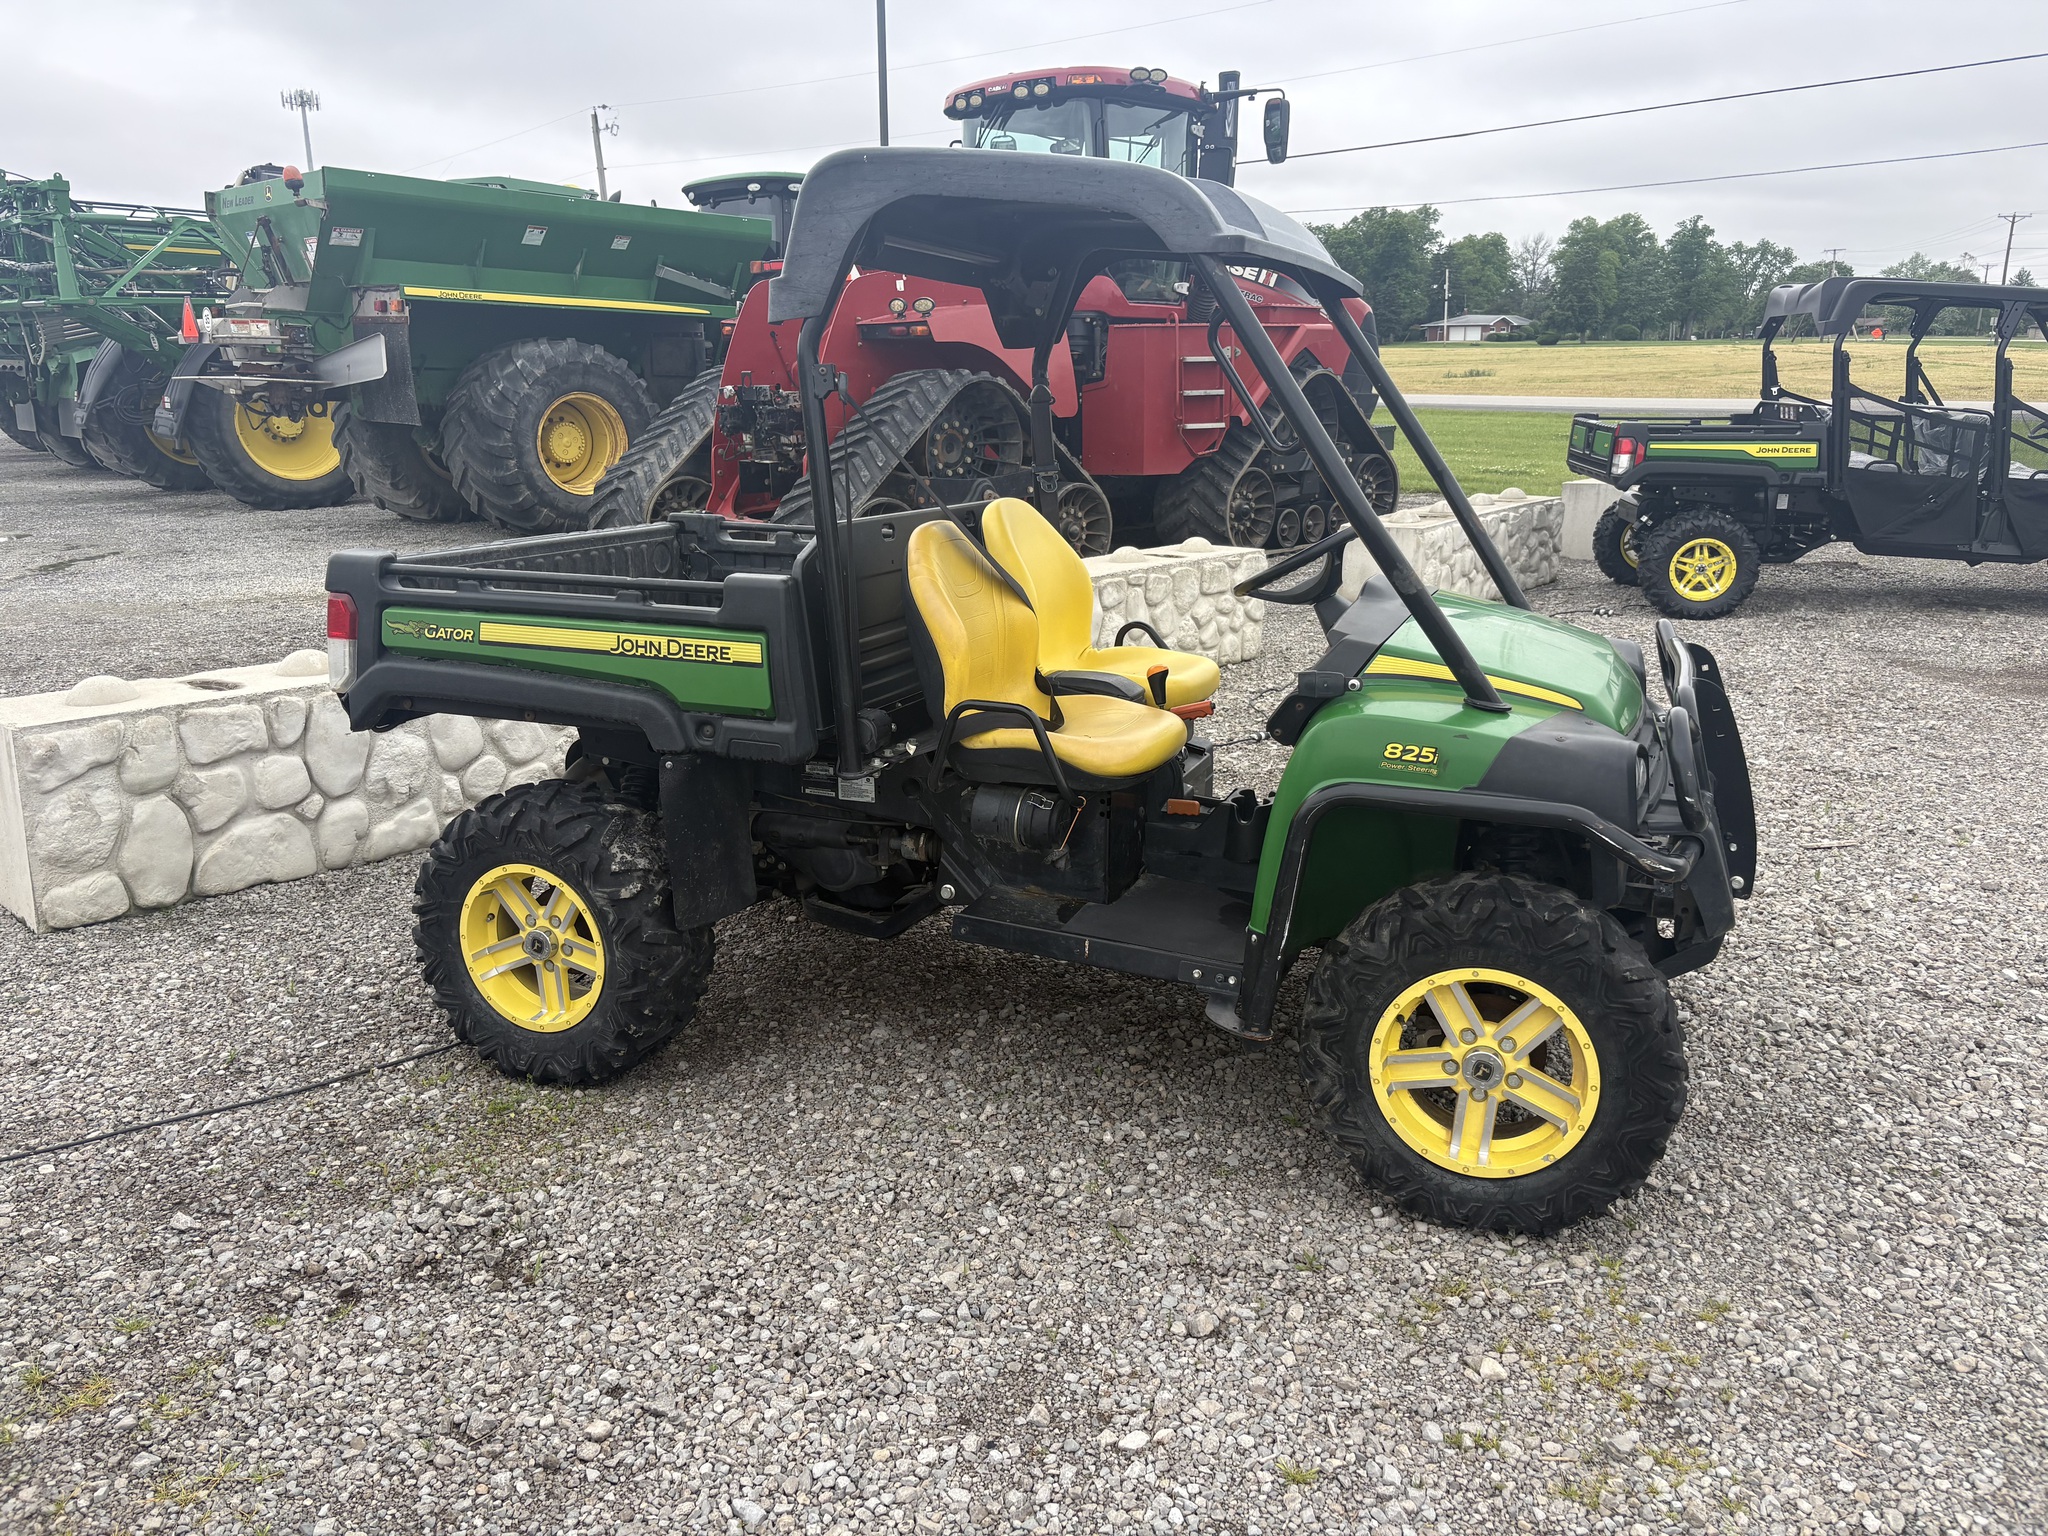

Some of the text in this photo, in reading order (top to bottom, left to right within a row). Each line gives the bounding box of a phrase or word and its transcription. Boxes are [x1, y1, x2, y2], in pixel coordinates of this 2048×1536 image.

[235, 195, 255, 207] LEADER
[1225, 265, 1259, 281] SE
[438, 290, 483, 300] JOHN DEERE
[1756, 446, 1812, 454] JOHN DEERE
[424, 624, 475, 643] GATOR
[609, 635, 732, 662] JOHN DEERE
[1383, 743, 1439, 764] 825i
[1380, 761, 1438, 776] Power Steering
